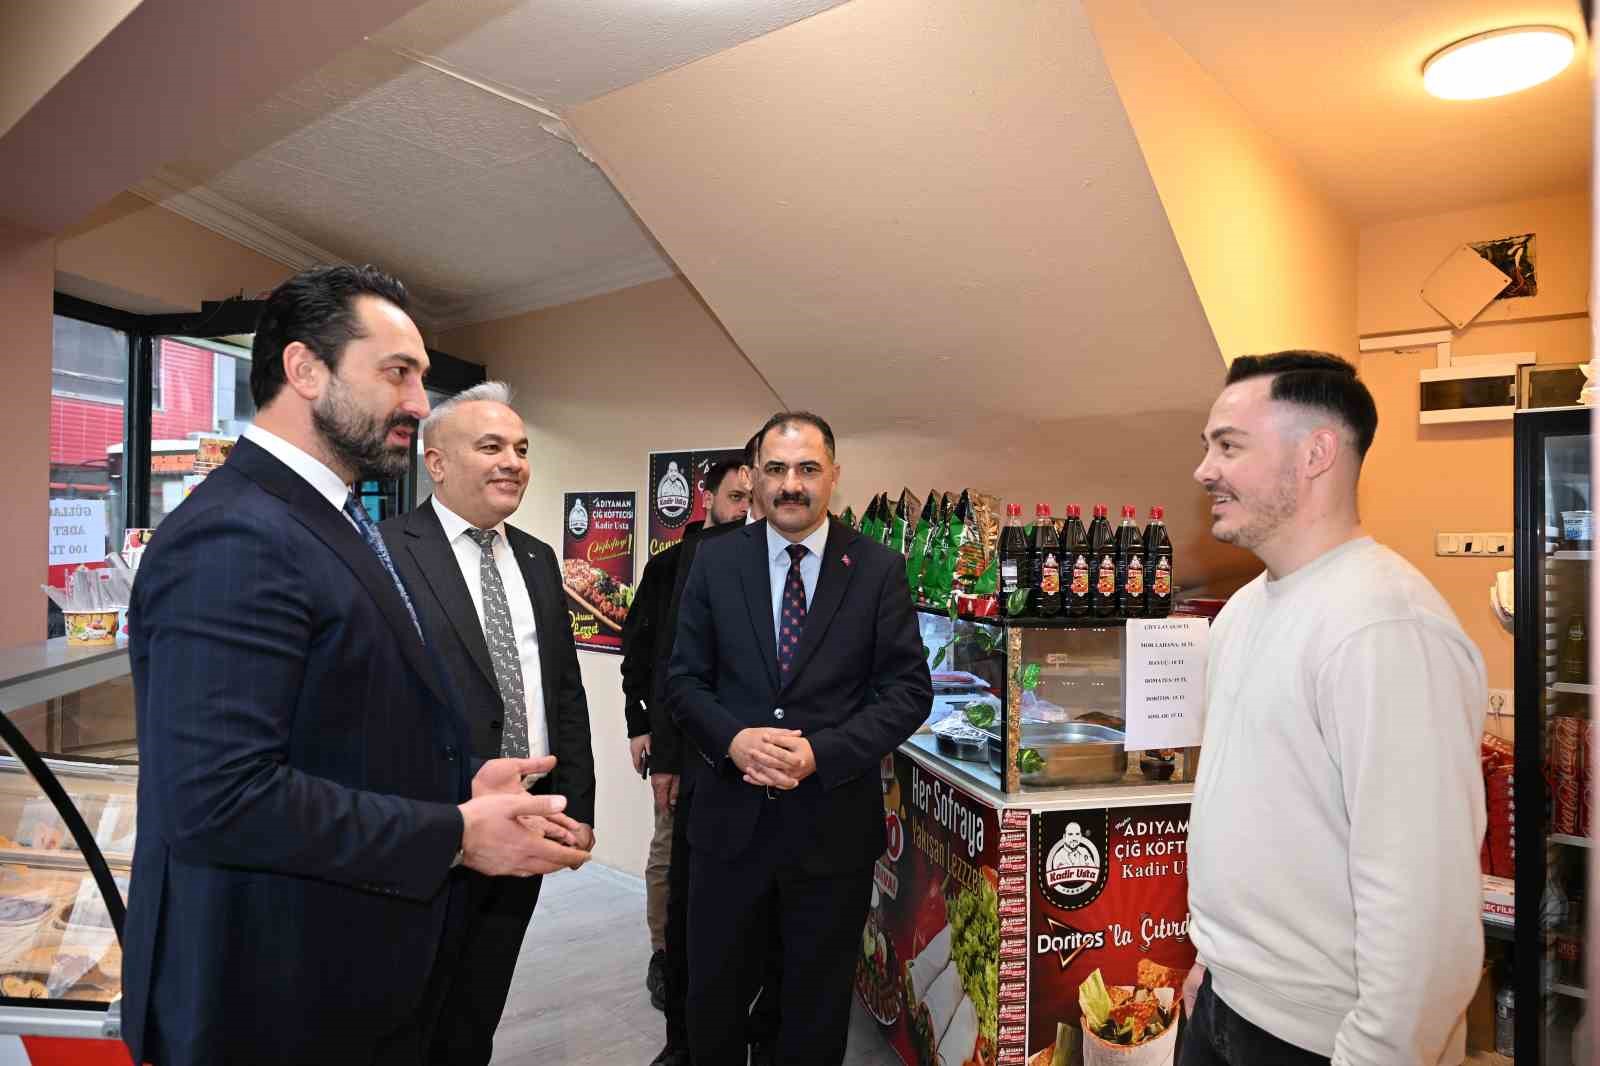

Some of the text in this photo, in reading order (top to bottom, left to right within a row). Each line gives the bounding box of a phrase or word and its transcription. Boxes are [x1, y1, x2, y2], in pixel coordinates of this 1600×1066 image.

[595, 499, 632, 508] ADIYAMAN
[595, 522, 613, 530] Kadir
[614, 521, 629, 530] Usta
[912, 765, 984, 859] Her Sofraya
[912, 815, 945, 866] Yakışan
[1115, 838, 1189, 862] ÇİĞ KÖFT
[1050, 868, 1096, 882] Kadir Usta
[1122, 861, 1168, 879] Kadir
[1037, 930, 1104, 954] Doritos
[1108, 923, 1133, 947] 'la
